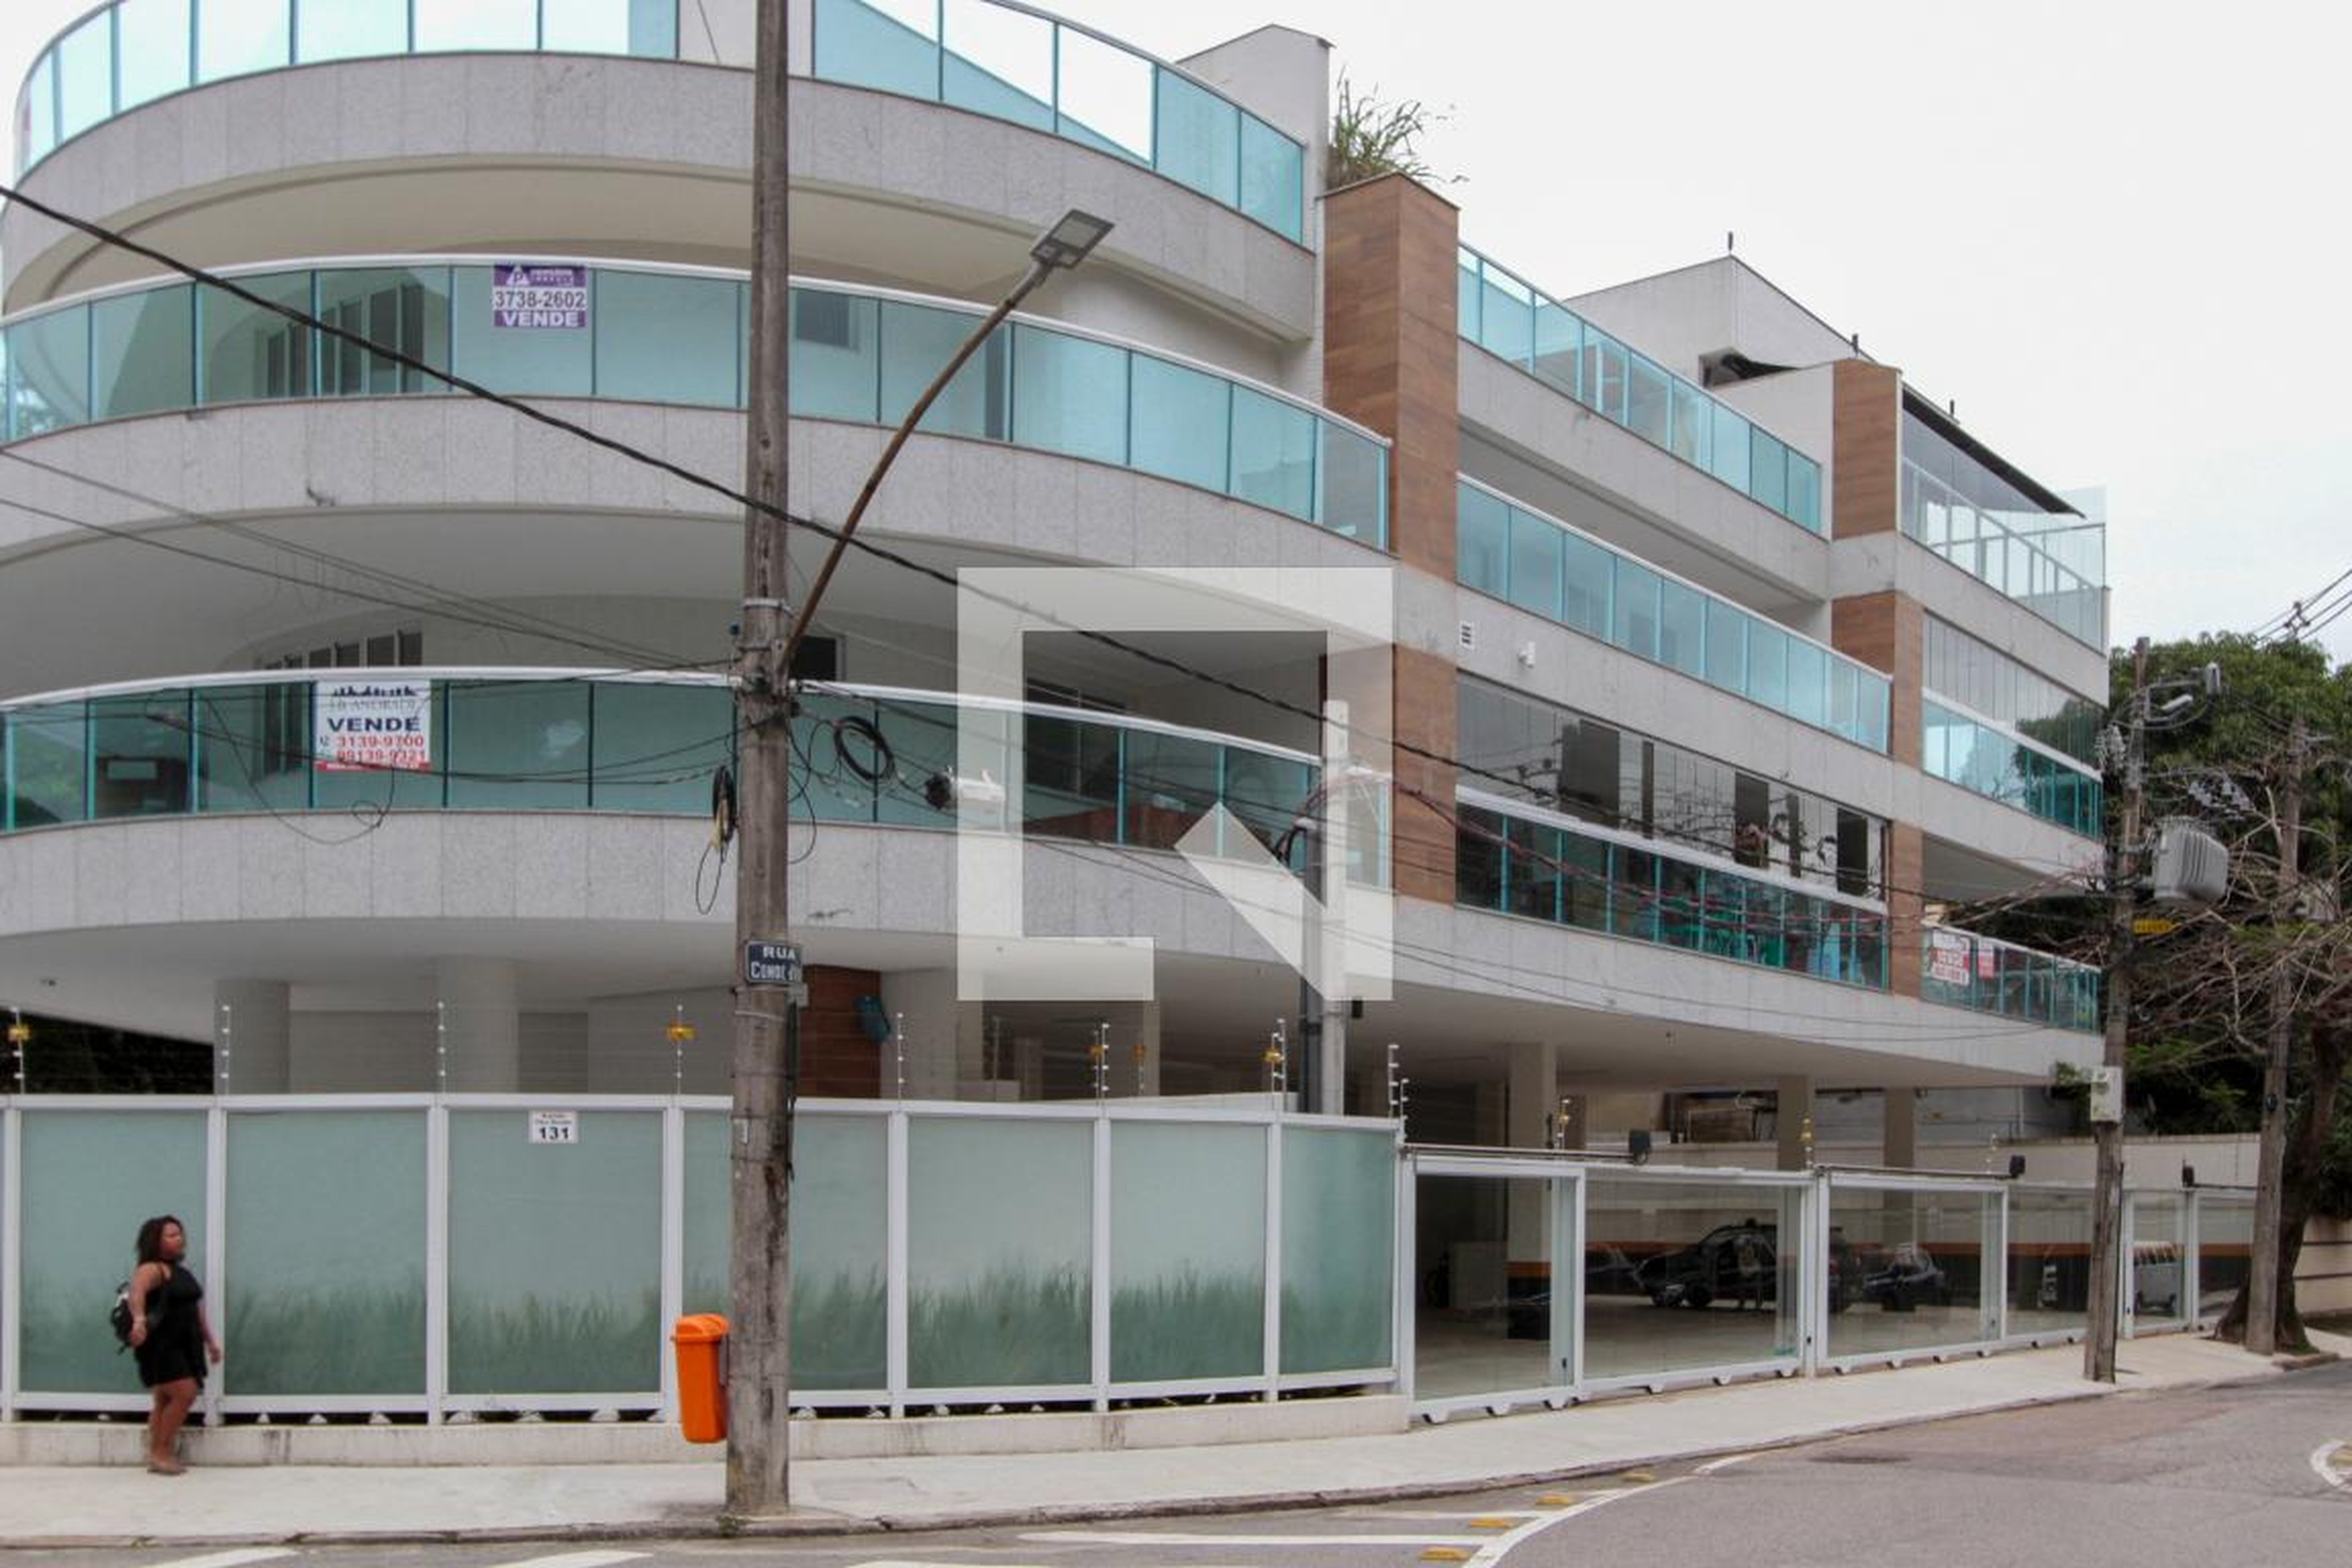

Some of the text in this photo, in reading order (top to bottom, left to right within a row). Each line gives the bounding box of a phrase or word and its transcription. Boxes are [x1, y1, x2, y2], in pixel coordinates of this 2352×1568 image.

[495, 290, 585, 307] 3738-2602
[502, 311, 579, 328] VENDE
[328, 717, 421, 732] VENDE
[763, 946, 796, 960] RUA
[540, 1126, 569, 1140] 131
